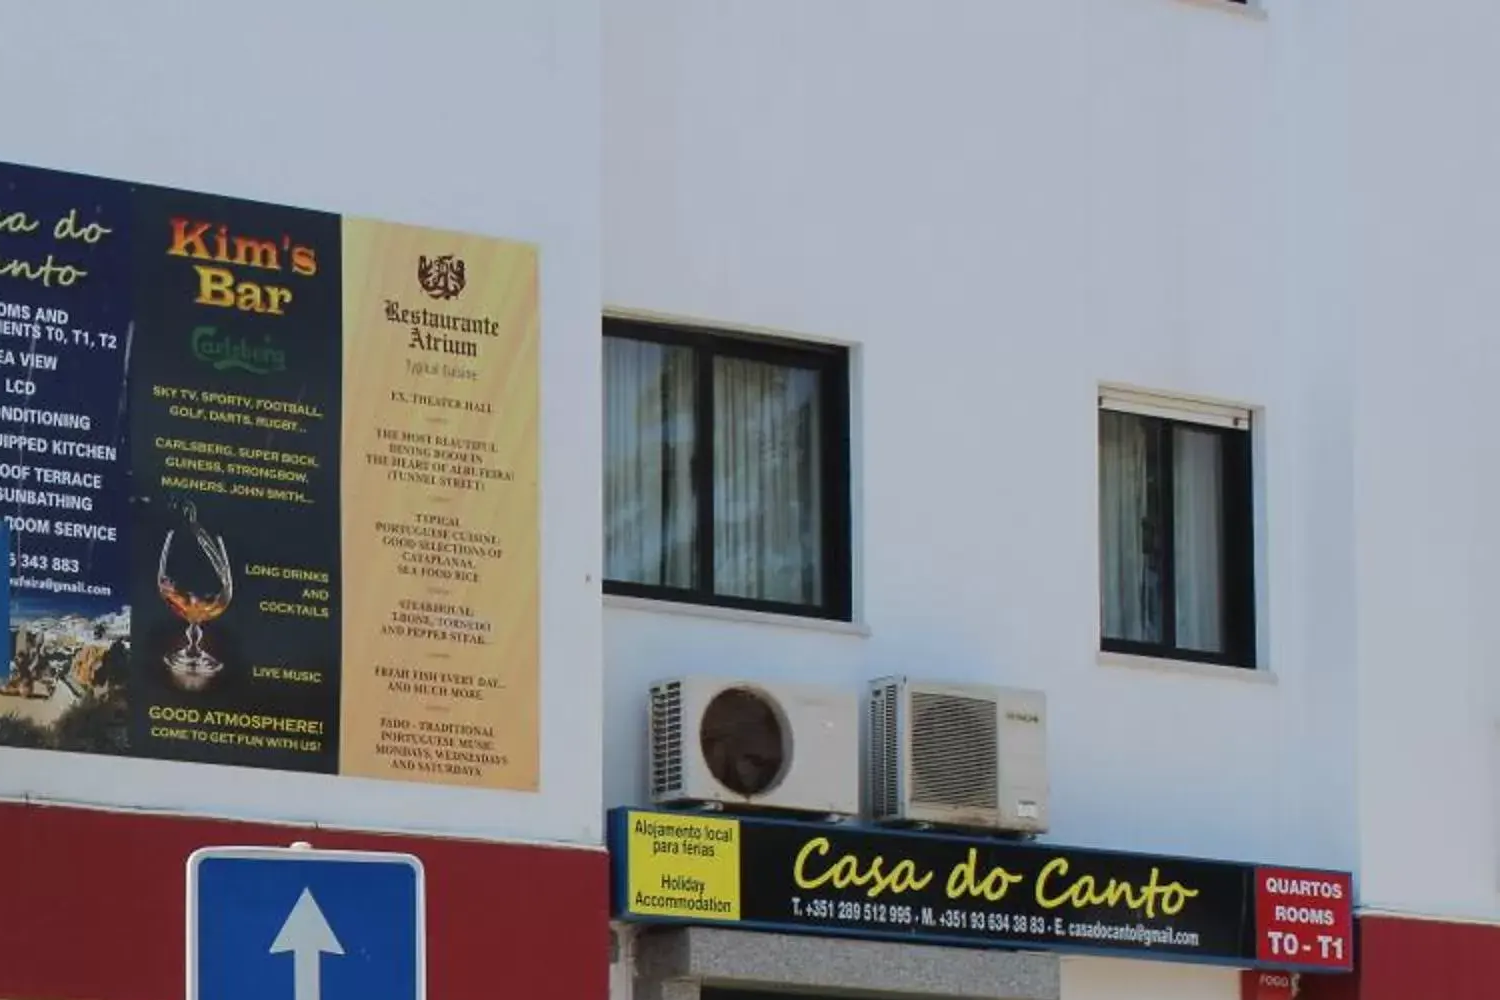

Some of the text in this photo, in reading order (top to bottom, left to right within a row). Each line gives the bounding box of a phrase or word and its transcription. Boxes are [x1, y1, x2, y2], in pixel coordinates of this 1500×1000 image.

[54, 208, 112, 243] do
[167, 217, 319, 277] Kim's
[194, 264, 292, 315] Bar
[35, 307, 68, 325] AND
[384, 300, 500, 337] Restaurante
[99, 333, 117, 349] T2
[191, 325, 287, 372] Carlsberg
[408, 327, 478, 358] Atrium
[20, 352, 58, 370] VIEW
[5, 379, 36, 395] LCD
[152, 385, 177, 398] SKY
[52, 440, 117, 460] KITCHEN
[239, 447, 279, 462] SUPER
[34, 467, 102, 489] TERRACE
[230, 484, 264, 498] JOHN
[54, 522, 117, 542] SERVICE
[22, 554, 48, 570] 343
[52, 558, 79, 573] 883
[245, 563, 330, 583] LONG DRINKS
[302, 589, 330, 601] AND
[259, 601, 330, 619] COCKTAILS
[252, 666, 322, 683] LIVE MUSIC
[148, 705, 324, 734] GOOD ATMOSPHERE!
[151, 726, 321, 752] COME TO GET FUN WITH US!
[635, 819, 733, 842] Alojamento local
[652, 839, 678, 857] para
[660, 874, 706, 894] Holiday
[793, 837, 1199, 919] Casa do Canto
[1265, 877, 1343, 899] QUARTOS
[634, 890, 732, 913] Accommodation
[805, 900, 834, 919] +351
[837, 902, 862, 921] 289
[863, 903, 887, 923] 512
[939, 909, 967, 928] +351
[970, 912, 985, 931] 93
[987, 914, 1011, 932] 634
[1012, 914, 1027, 933] 38
[1029, 916, 1045, 934] 83
[1068, 920, 1199, 947] casadocanto@gmail.com
[1274, 905, 1335, 926] ROOMS
[1317, 936, 1345, 960] T1
